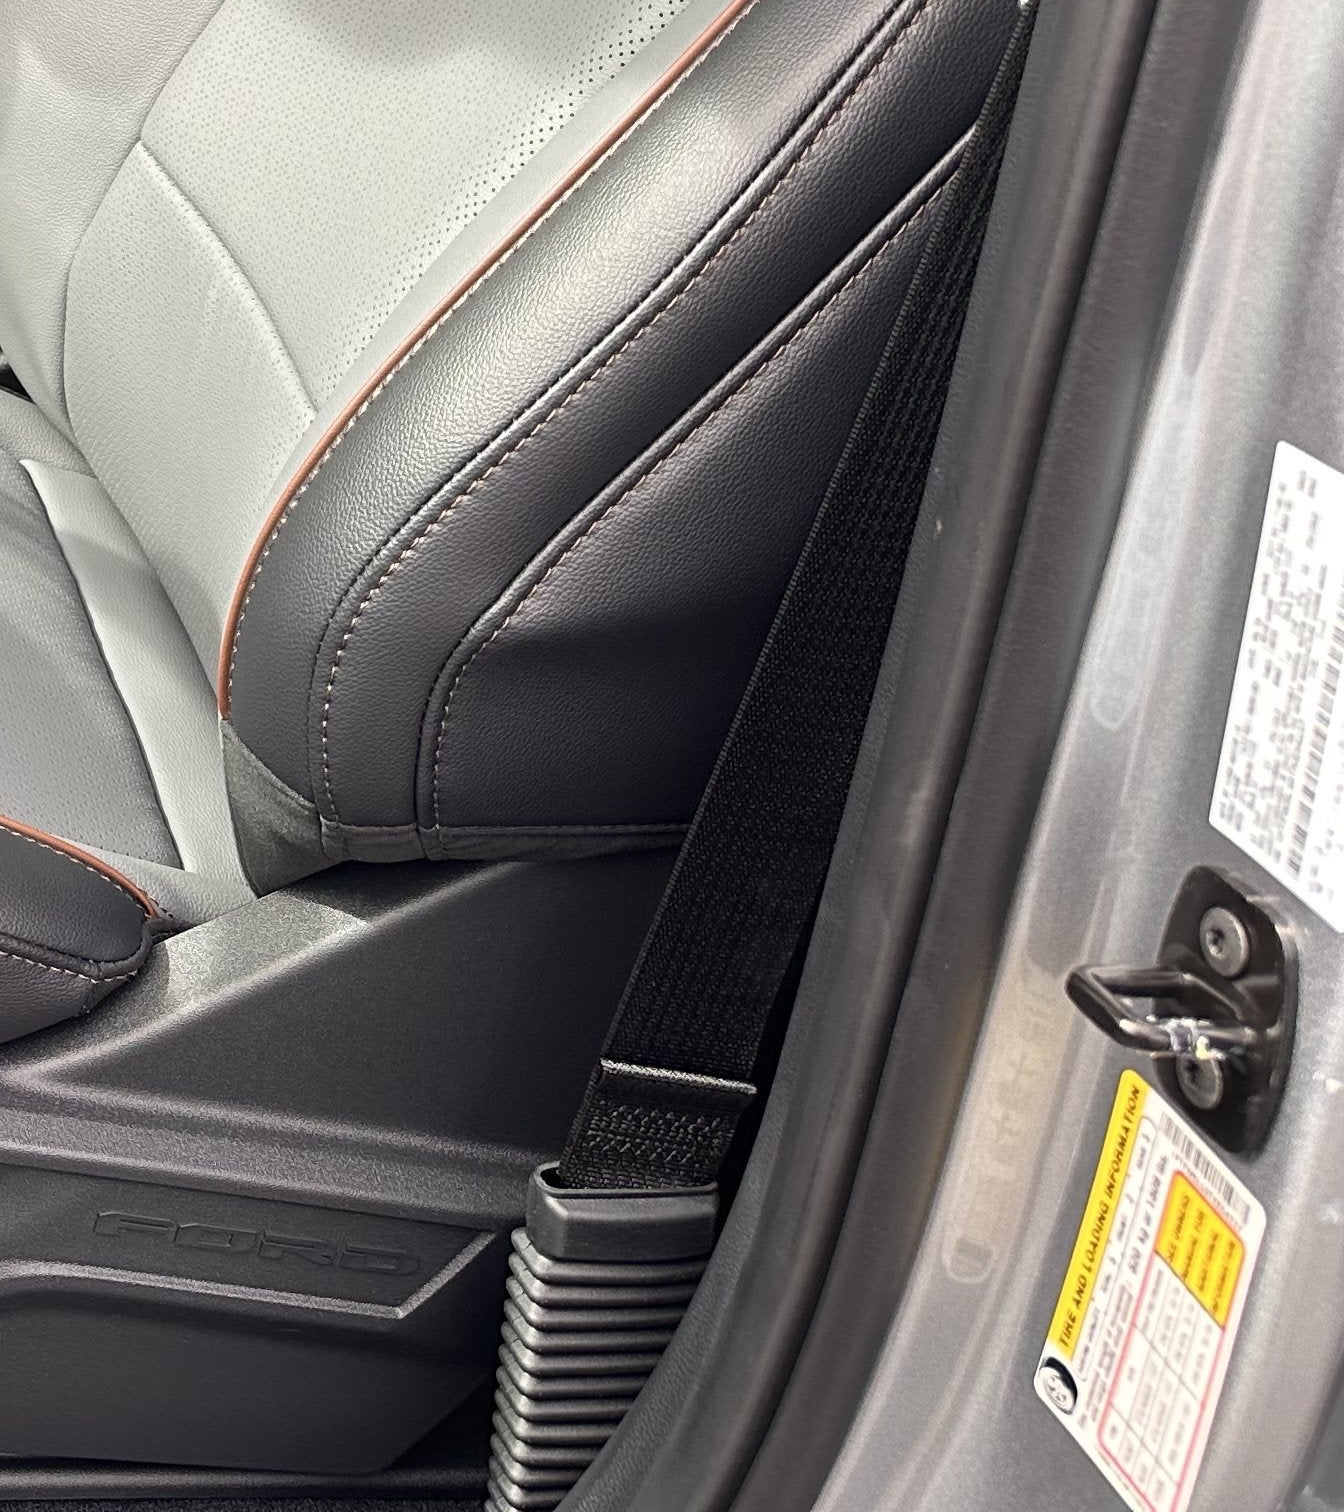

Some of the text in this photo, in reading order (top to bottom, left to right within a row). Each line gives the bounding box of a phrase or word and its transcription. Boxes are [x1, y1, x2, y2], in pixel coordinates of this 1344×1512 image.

[93, 1210, 419, 1276] FORD
[1059, 1308, 1078, 1348] TIRE
[1071, 1274, 1088, 1308] AND
[1083, 1200, 1110, 1273] LOADING
[1105, 1085, 1141, 1199] INFORMATION
